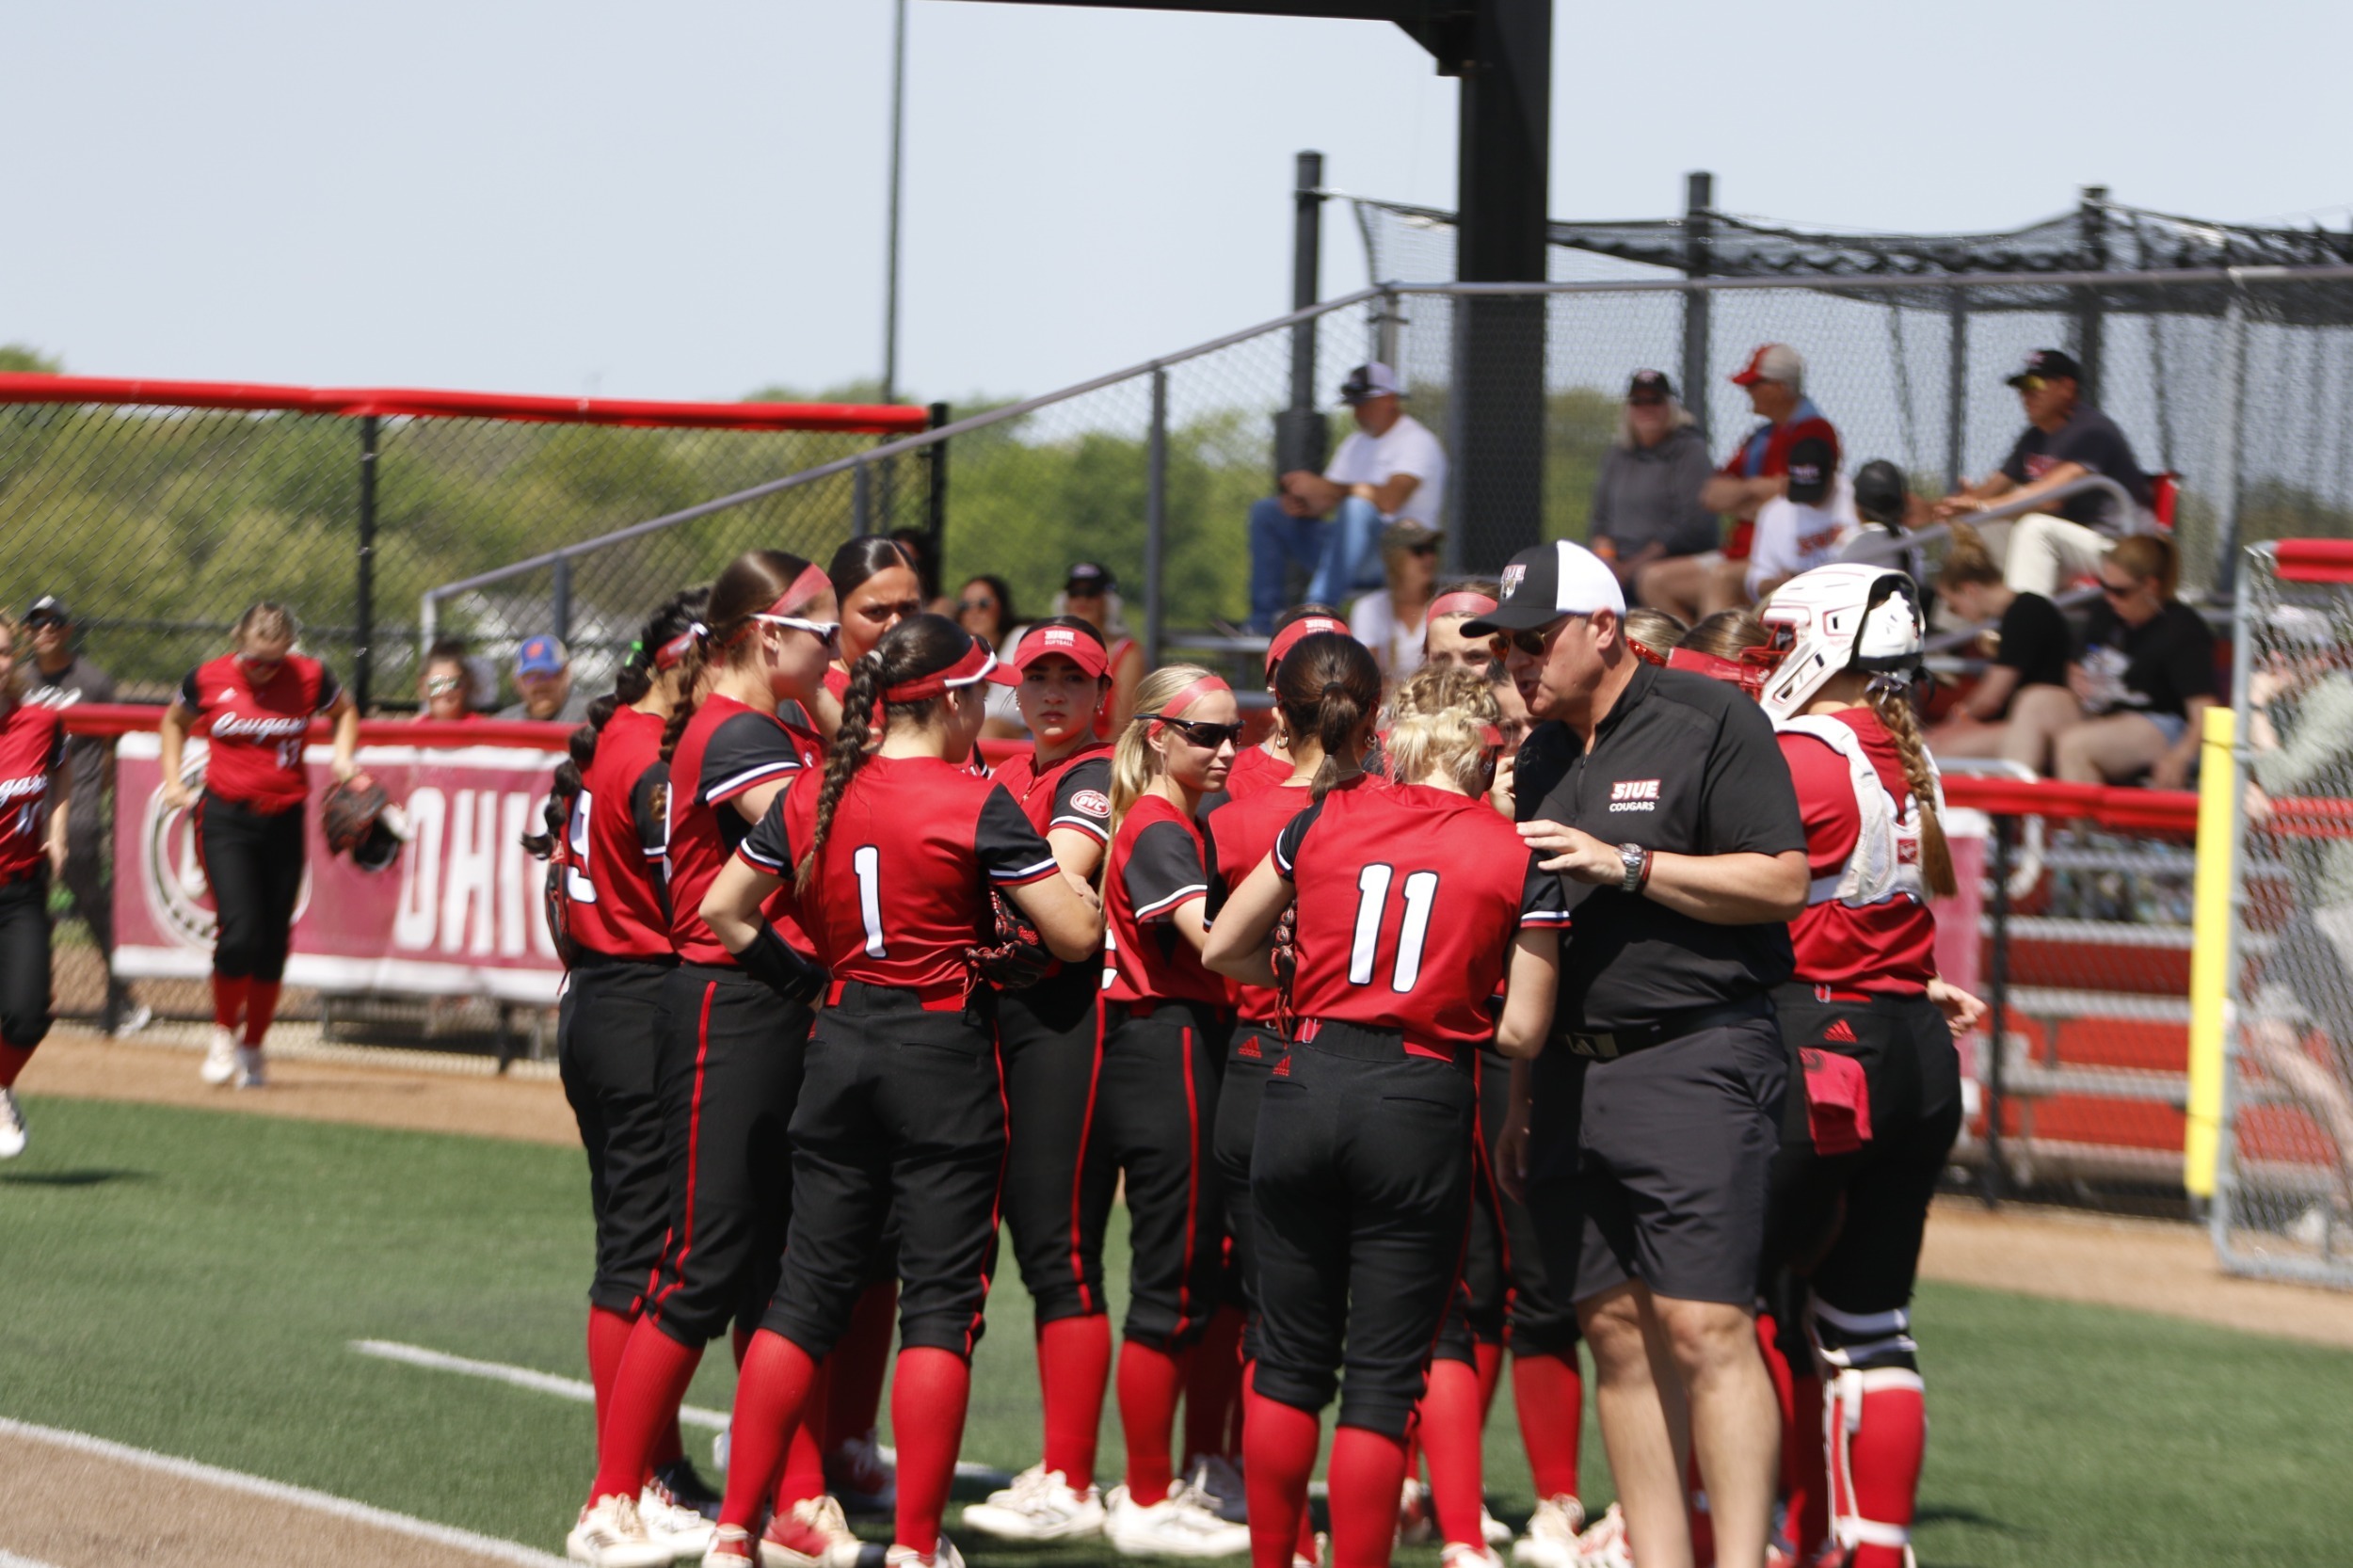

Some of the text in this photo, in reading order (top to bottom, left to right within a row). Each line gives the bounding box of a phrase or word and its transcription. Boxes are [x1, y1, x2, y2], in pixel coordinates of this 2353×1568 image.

[1610, 779, 1660, 800] SIUE
[1077, 794, 1106, 812] OVC
[1609, 801, 1656, 813] COUGARS
[852, 844, 888, 958] 1
[1347, 861, 1439, 994] 11
